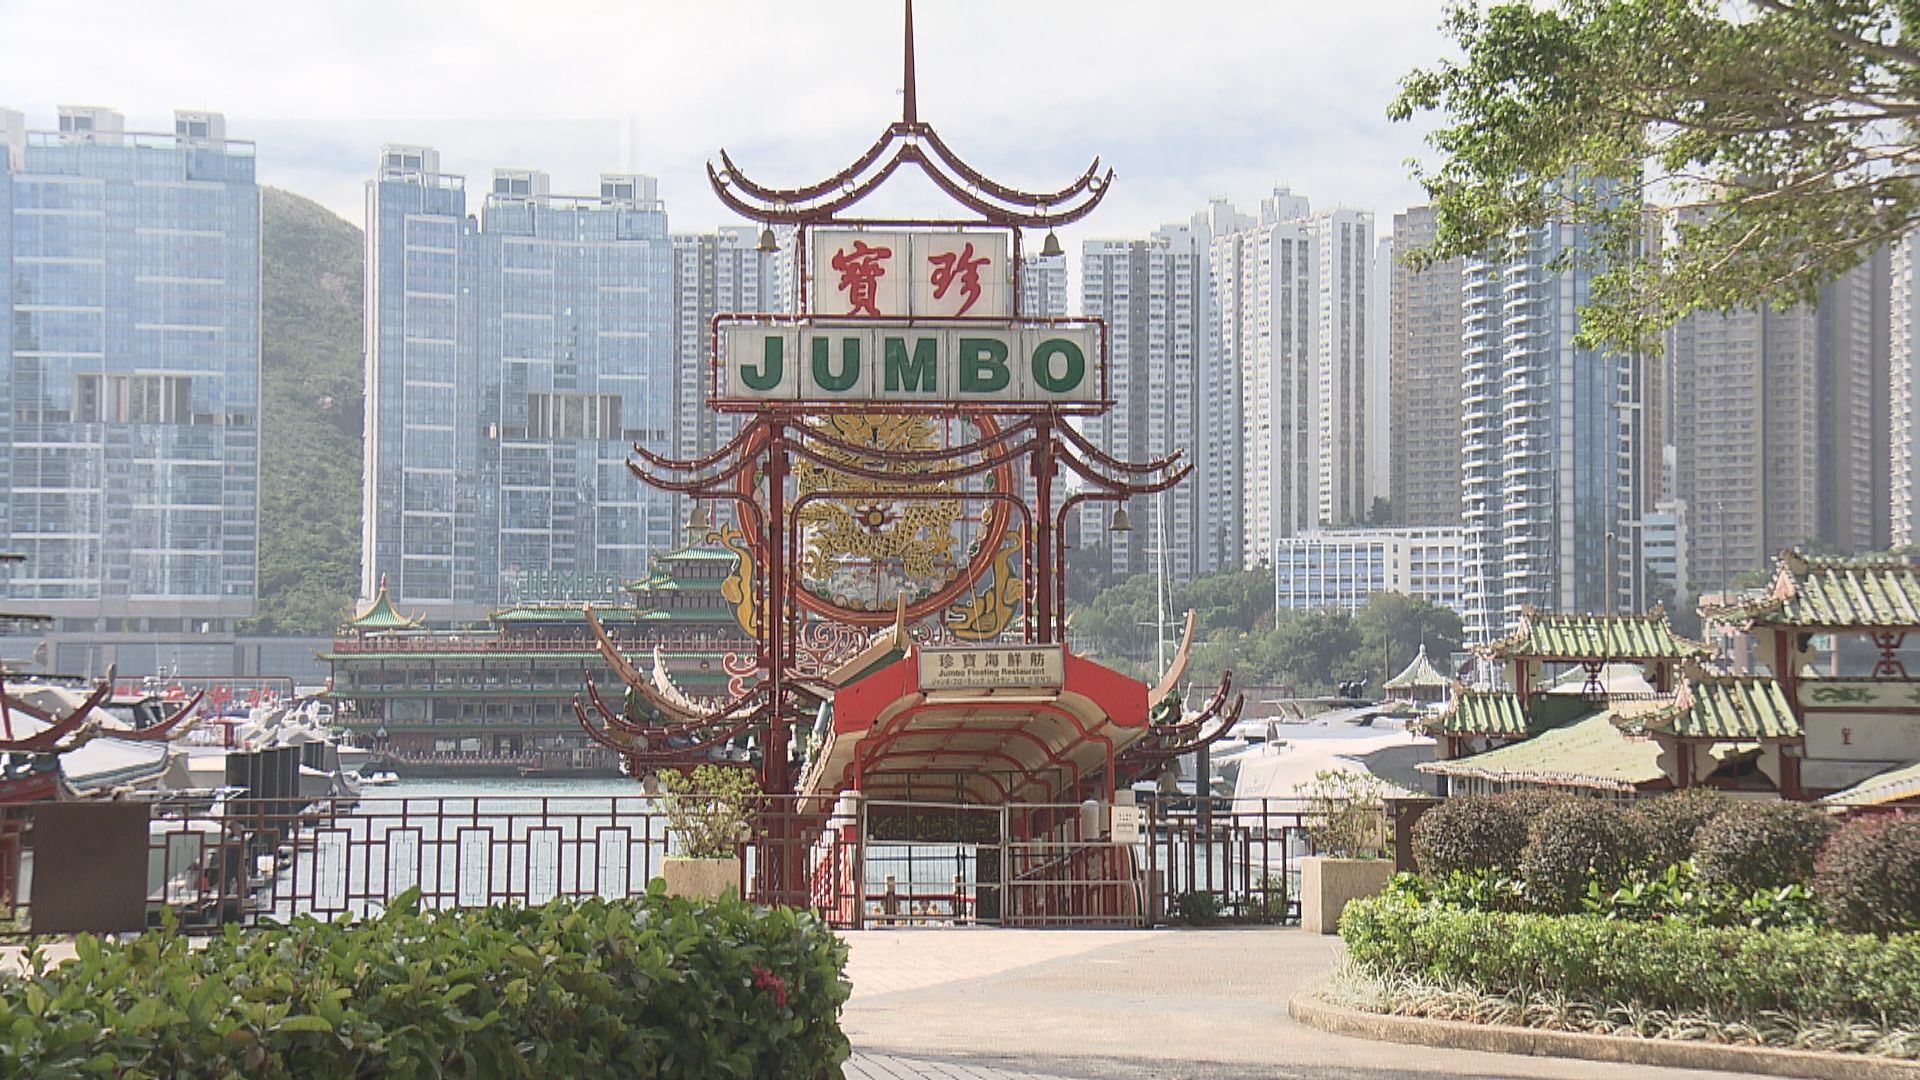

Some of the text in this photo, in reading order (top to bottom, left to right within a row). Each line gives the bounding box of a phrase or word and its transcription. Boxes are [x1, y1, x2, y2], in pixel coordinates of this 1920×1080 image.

[739, 336, 1086, 392] JUMBO
[938, 652, 1045, 668] 珍寶海鮮舫
[938, 667, 1045, 677] Jumbo Floating Restaurant
